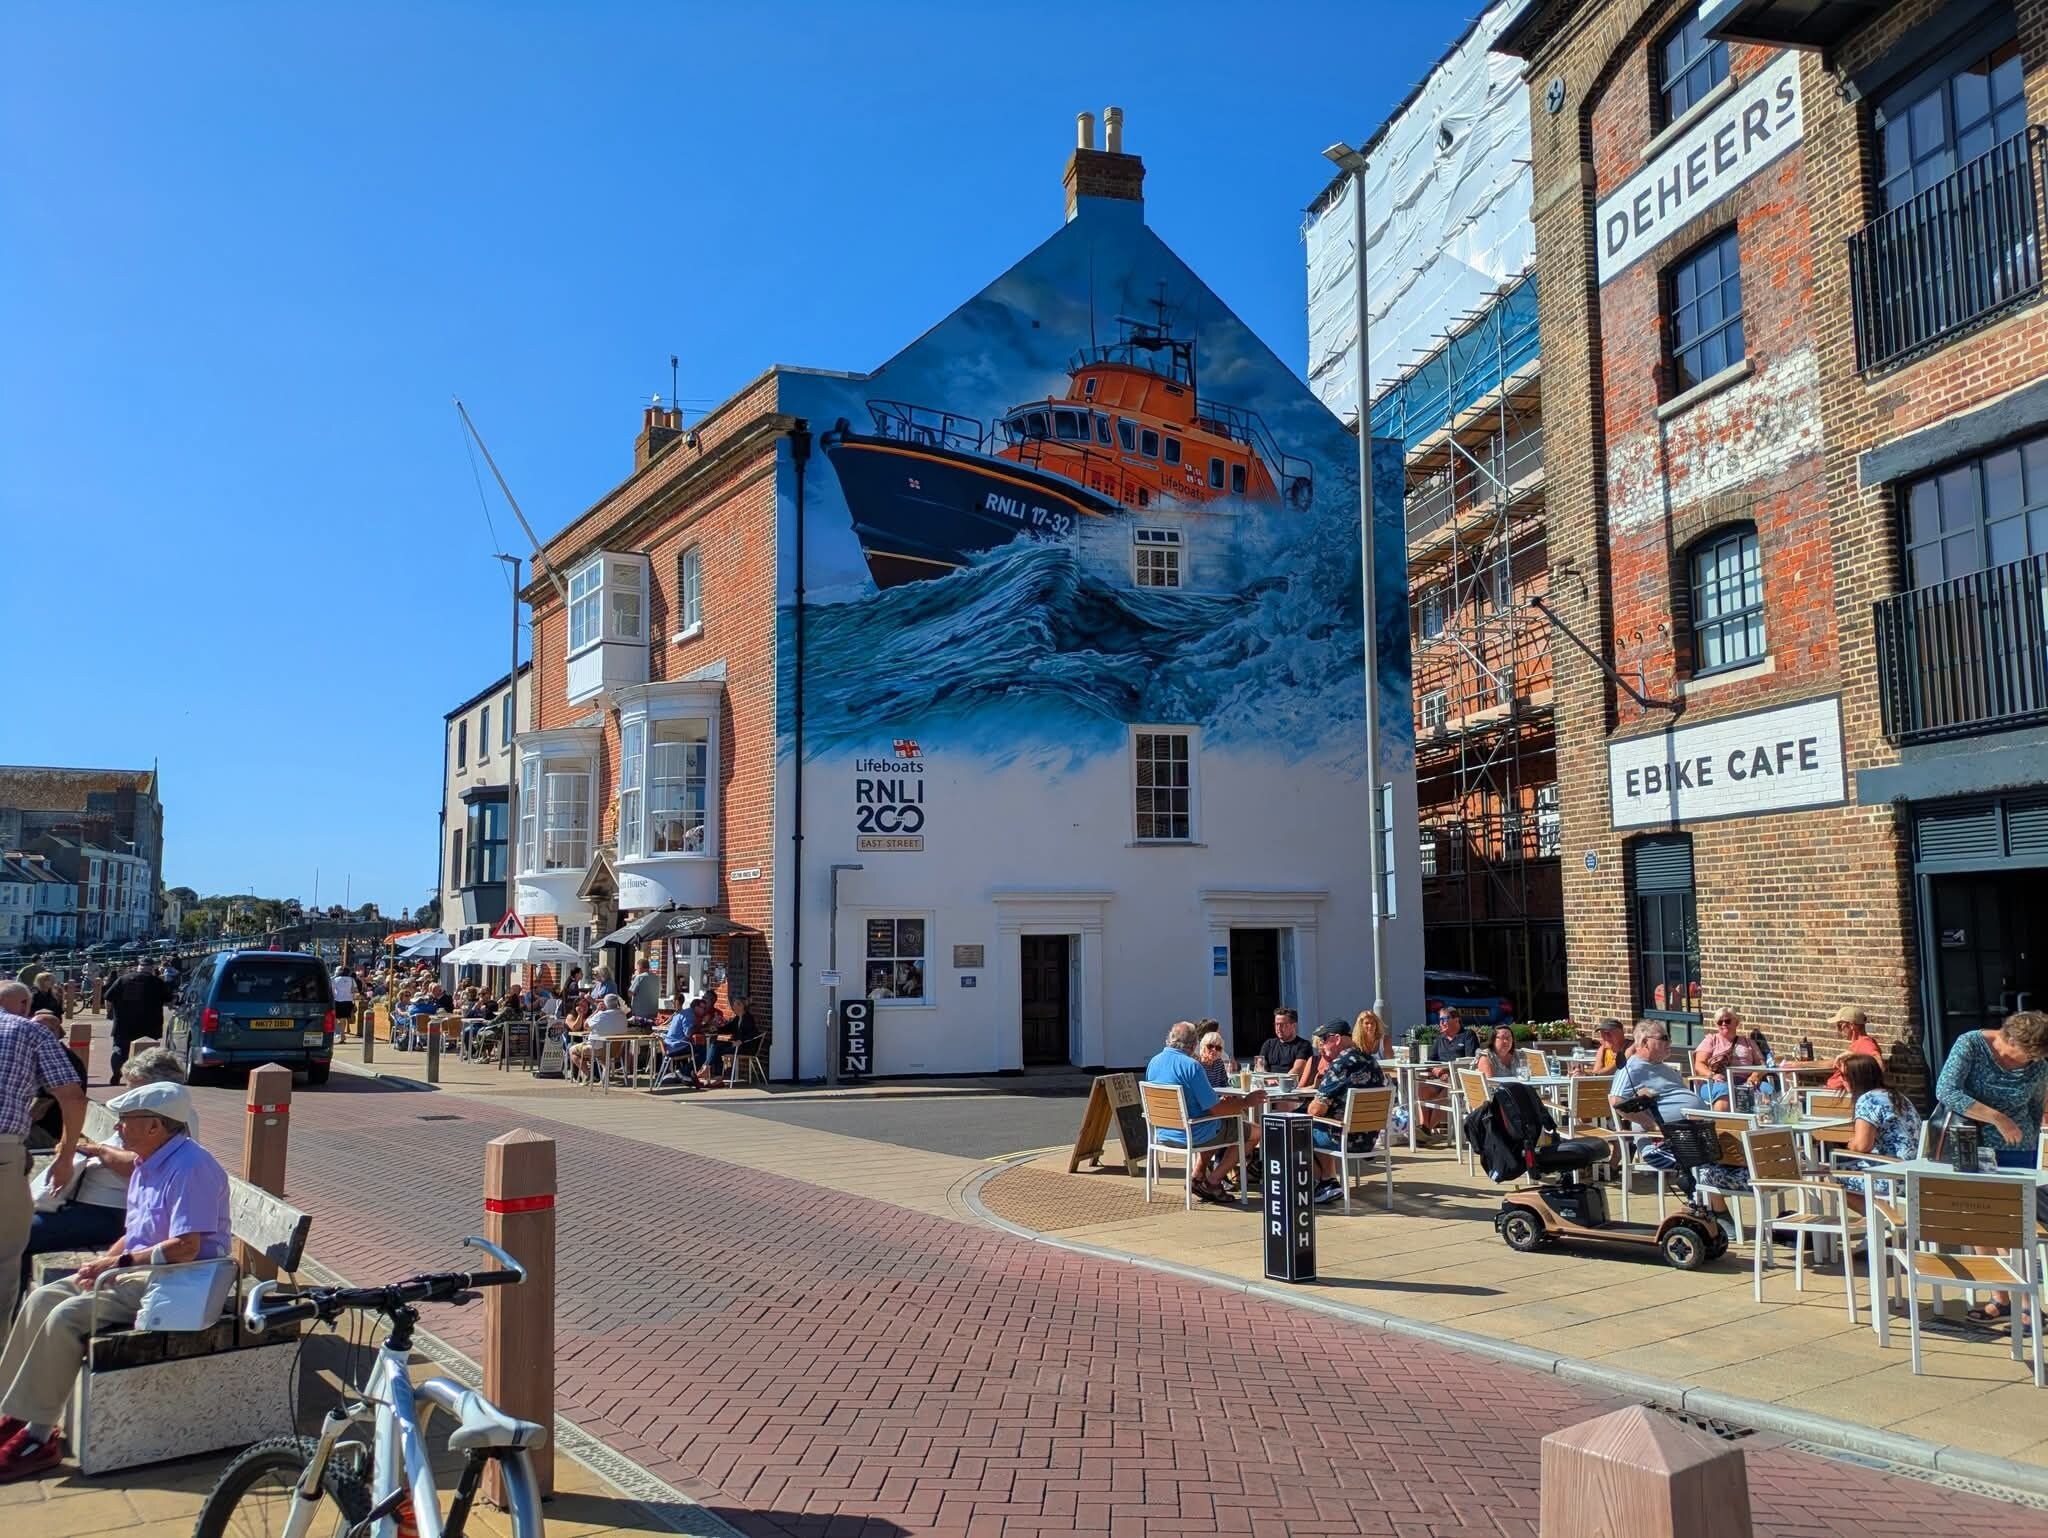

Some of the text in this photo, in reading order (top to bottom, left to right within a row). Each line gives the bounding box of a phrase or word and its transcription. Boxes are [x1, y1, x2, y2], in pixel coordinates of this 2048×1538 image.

[1606, 76, 1796, 258] DEHEERS
[1161, 472, 1206, 501] Lifeboats
[985, 493, 1070, 536] RNLI 17-32
[856, 759, 924, 773] Lifeboats
[856, 779, 924, 804] RNLI
[1626, 736, 1819, 797] EBIKE CAFE
[861, 839, 919, 848] EAST STREET
[846, 1004, 868, 1071] OPEN
[1270, 1159, 1282, 1236] BEER
[1298, 1151, 1309, 1247] LUNCH
